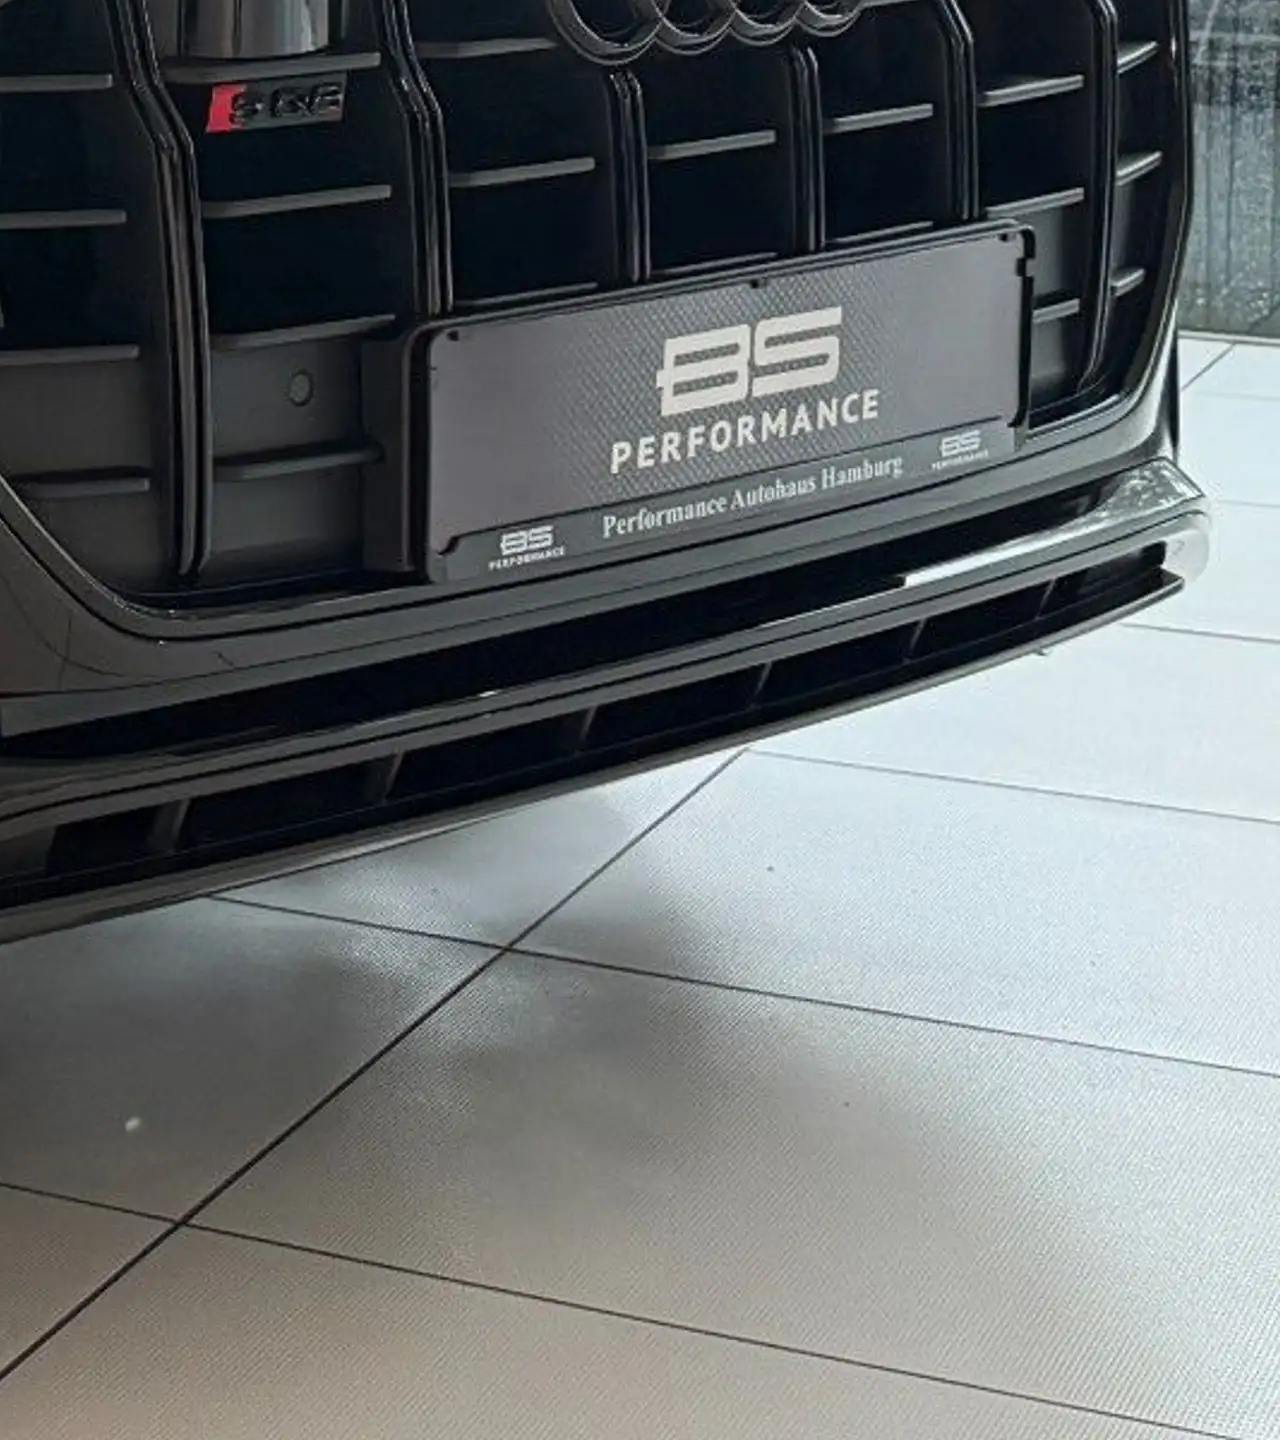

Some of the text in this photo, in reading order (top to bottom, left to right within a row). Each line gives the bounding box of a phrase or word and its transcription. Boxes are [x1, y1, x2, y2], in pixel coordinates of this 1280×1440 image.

[610, 389, 880, 474] PERFORMANCE
[602, 455, 905, 539] Performance Autohaus Hamburg
